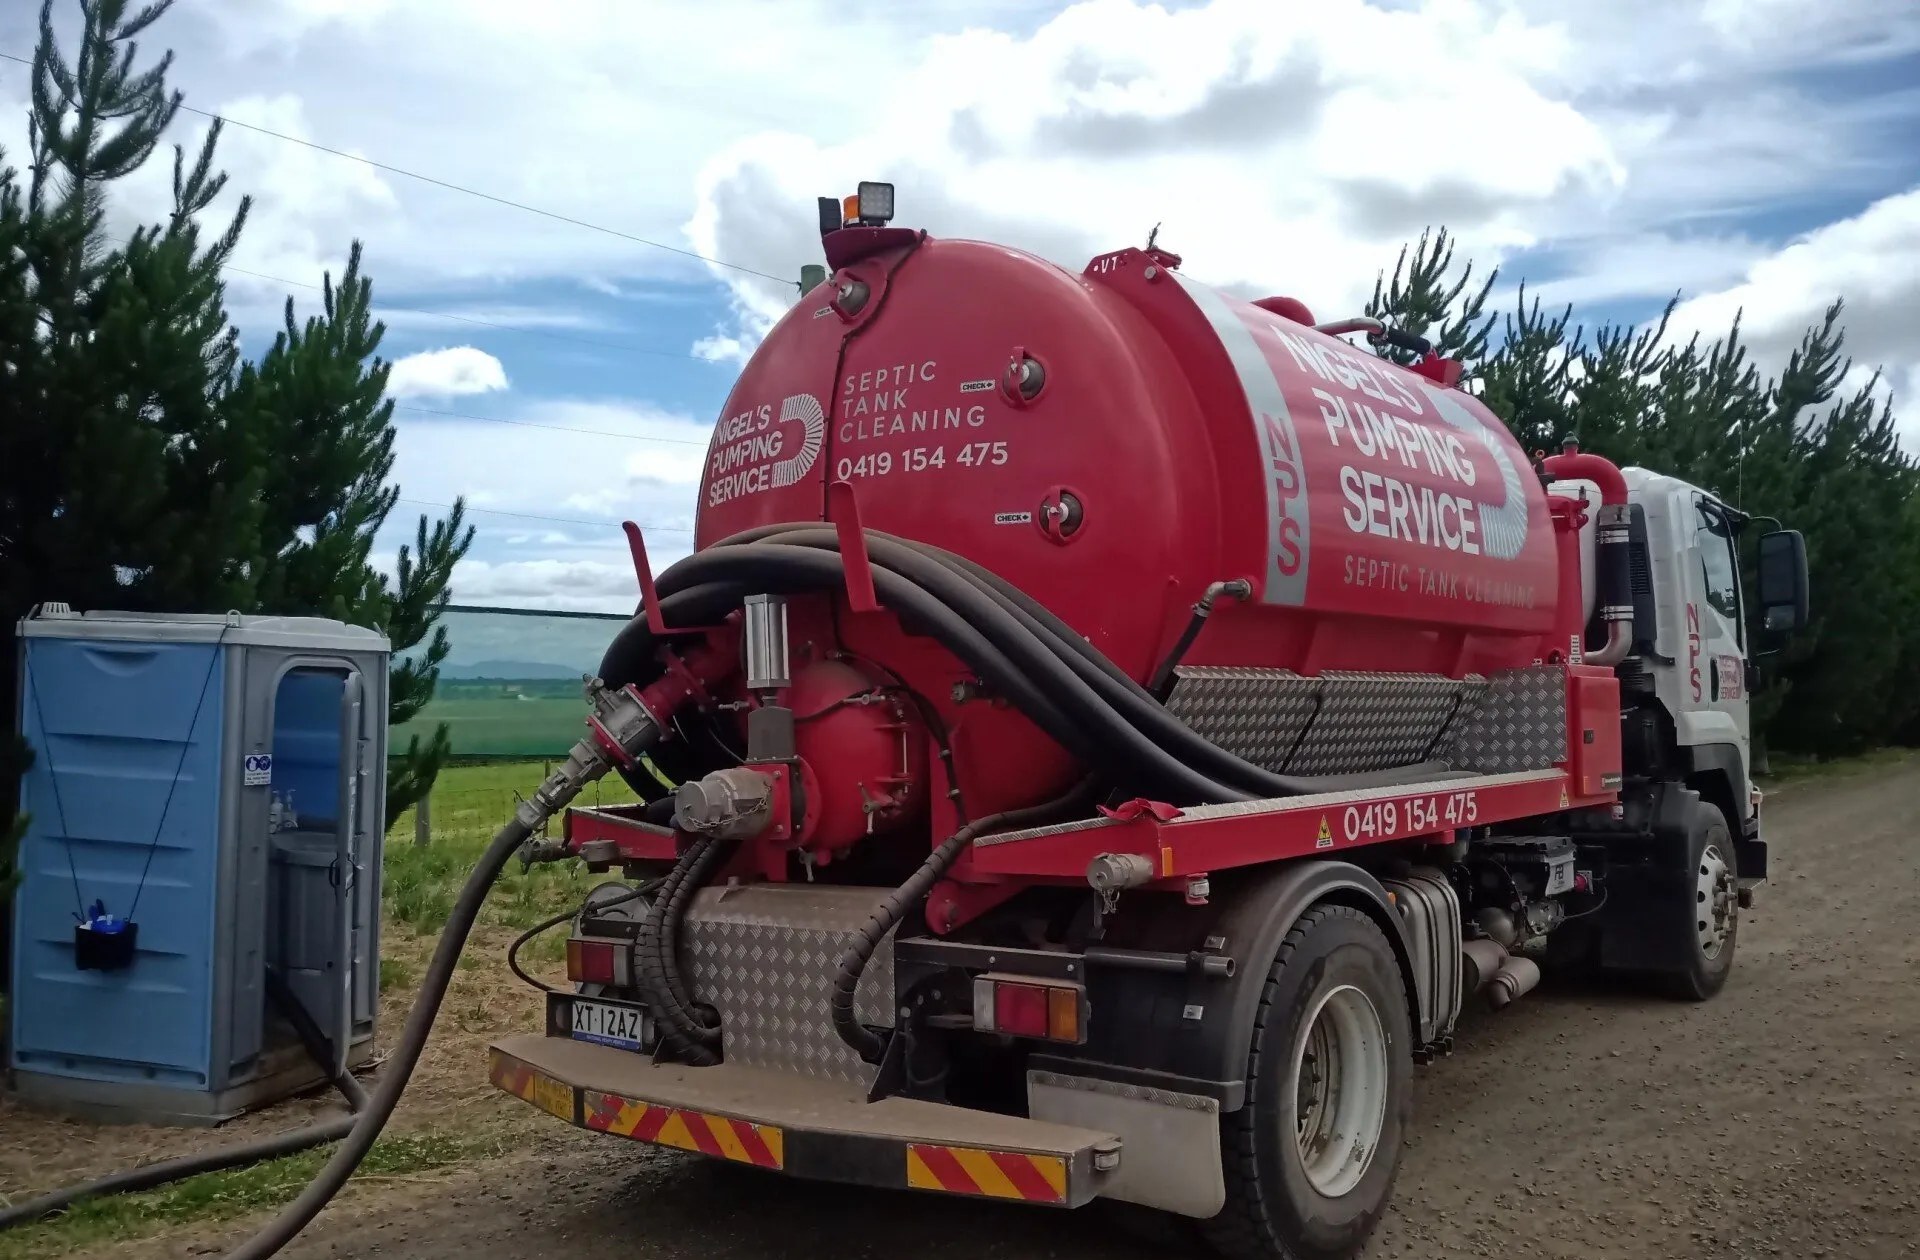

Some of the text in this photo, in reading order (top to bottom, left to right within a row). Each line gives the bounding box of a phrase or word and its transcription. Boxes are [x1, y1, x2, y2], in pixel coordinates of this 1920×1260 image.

[844, 361, 936, 395] SEPTIC
[962, 382, 986, 391] CHECK
[1271, 326, 1423, 415] NIGEL'S
[840, 405, 985, 443] CLEANING
[843, 388, 907, 419] TANK
[715, 404, 771, 449] NIGEL'S
[1312, 387, 1476, 486] PUMPING
[712, 430, 783, 478] PUMPING
[837, 441, 1008, 480] 0419 154 475
[709, 464, 770, 507] SERVICE
[996, 514, 1022, 523] CHECK
[1340, 465, 1480, 555] SERVICE
[1344, 554, 1534, 609] SEPTIC TANK CLEANING
[1344, 792, 1477, 841] 0419 154 475
